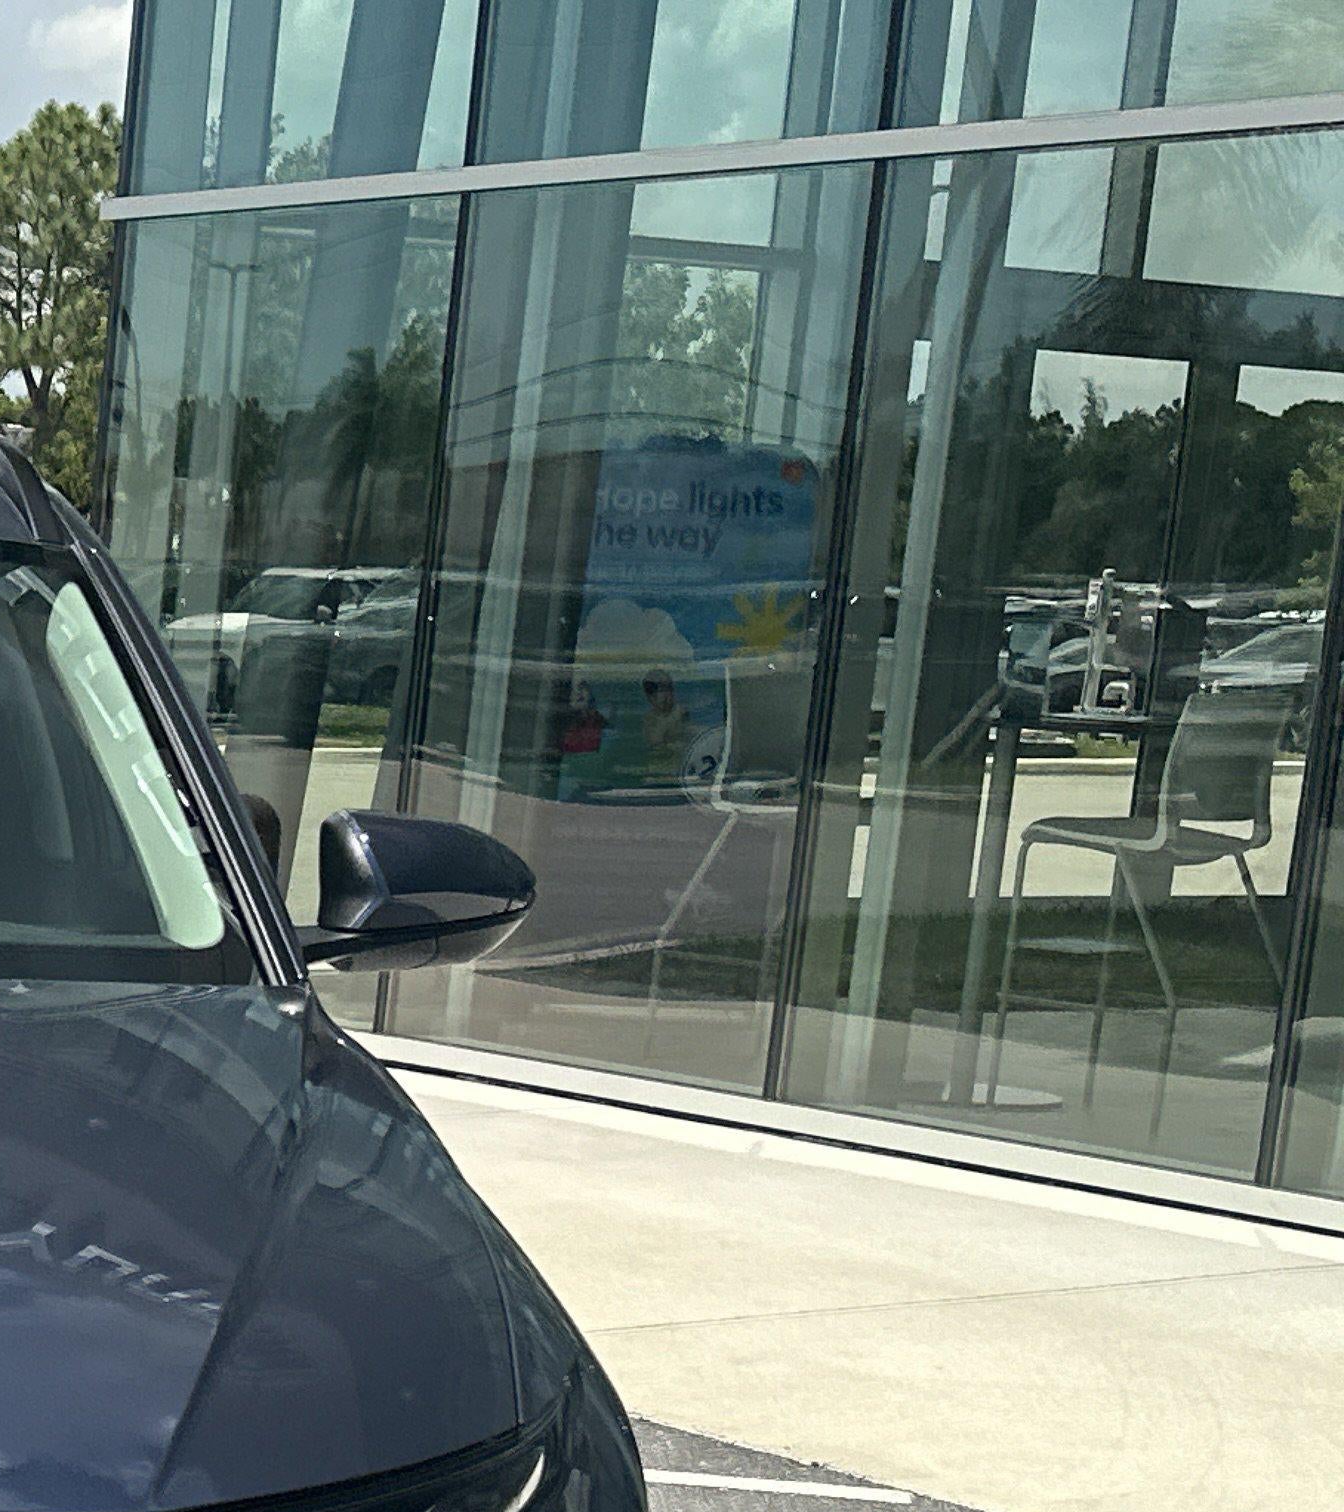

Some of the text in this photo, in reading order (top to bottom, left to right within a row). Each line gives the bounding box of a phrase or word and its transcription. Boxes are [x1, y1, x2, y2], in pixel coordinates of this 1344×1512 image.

[688, 480, 785, 525] lights
[594, 516, 723, 557] he way
